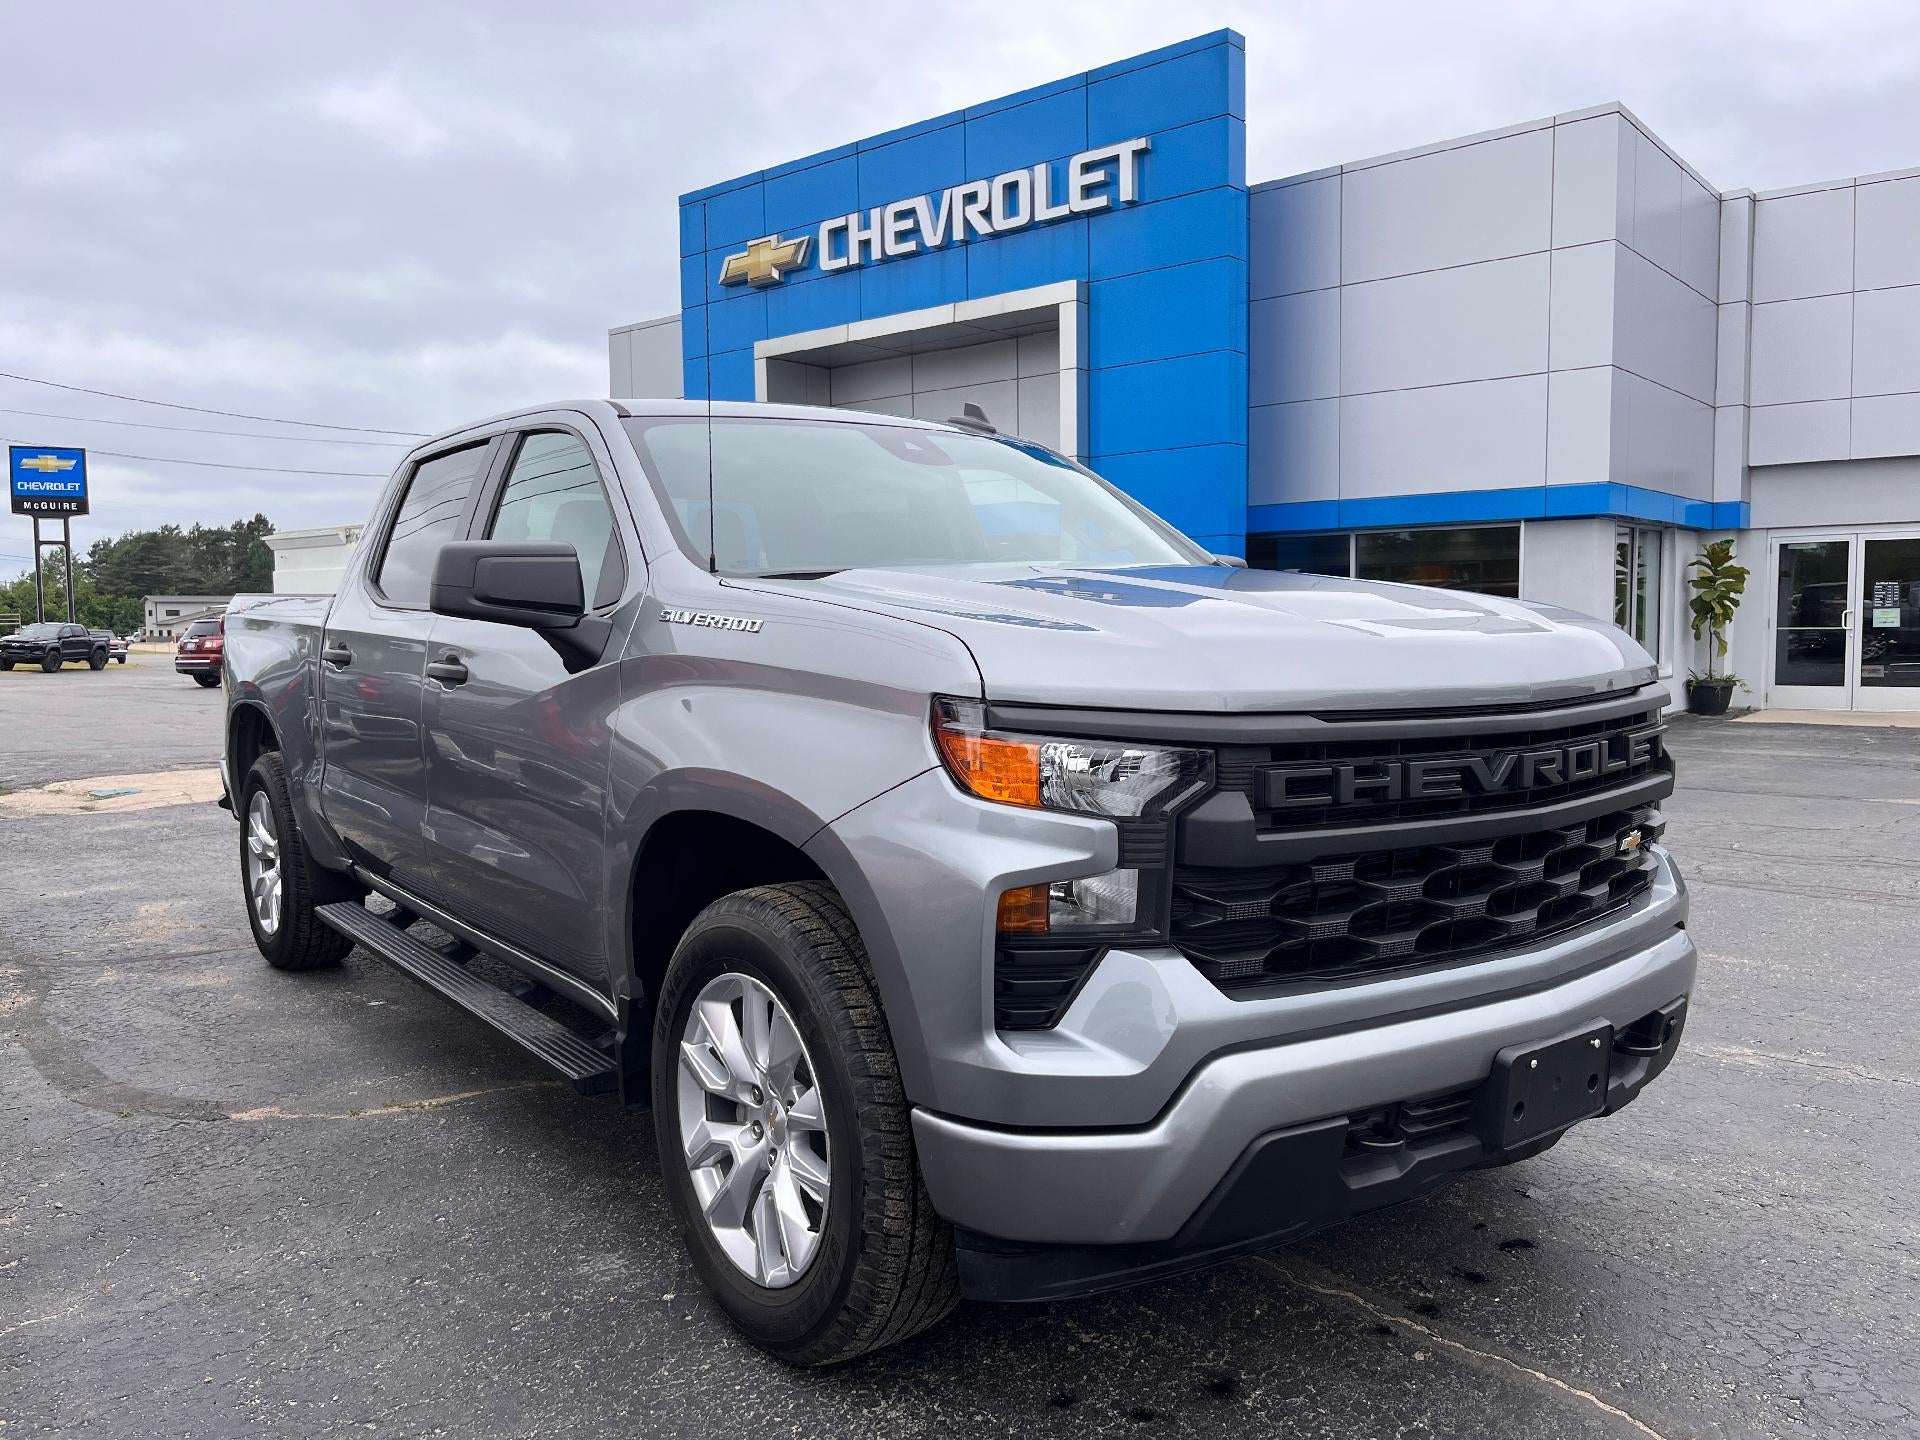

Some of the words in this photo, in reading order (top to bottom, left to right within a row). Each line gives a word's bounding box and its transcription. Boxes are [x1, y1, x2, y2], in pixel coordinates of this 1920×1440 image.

[818, 136, 1151, 271] CHEVROLET
[17, 481, 81, 491] CHEVROLET
[23, 501, 78, 510] McGUIRE
[659, 609, 764, 633] SILVERADO
[1262, 724, 1669, 808] CHEVROLET
